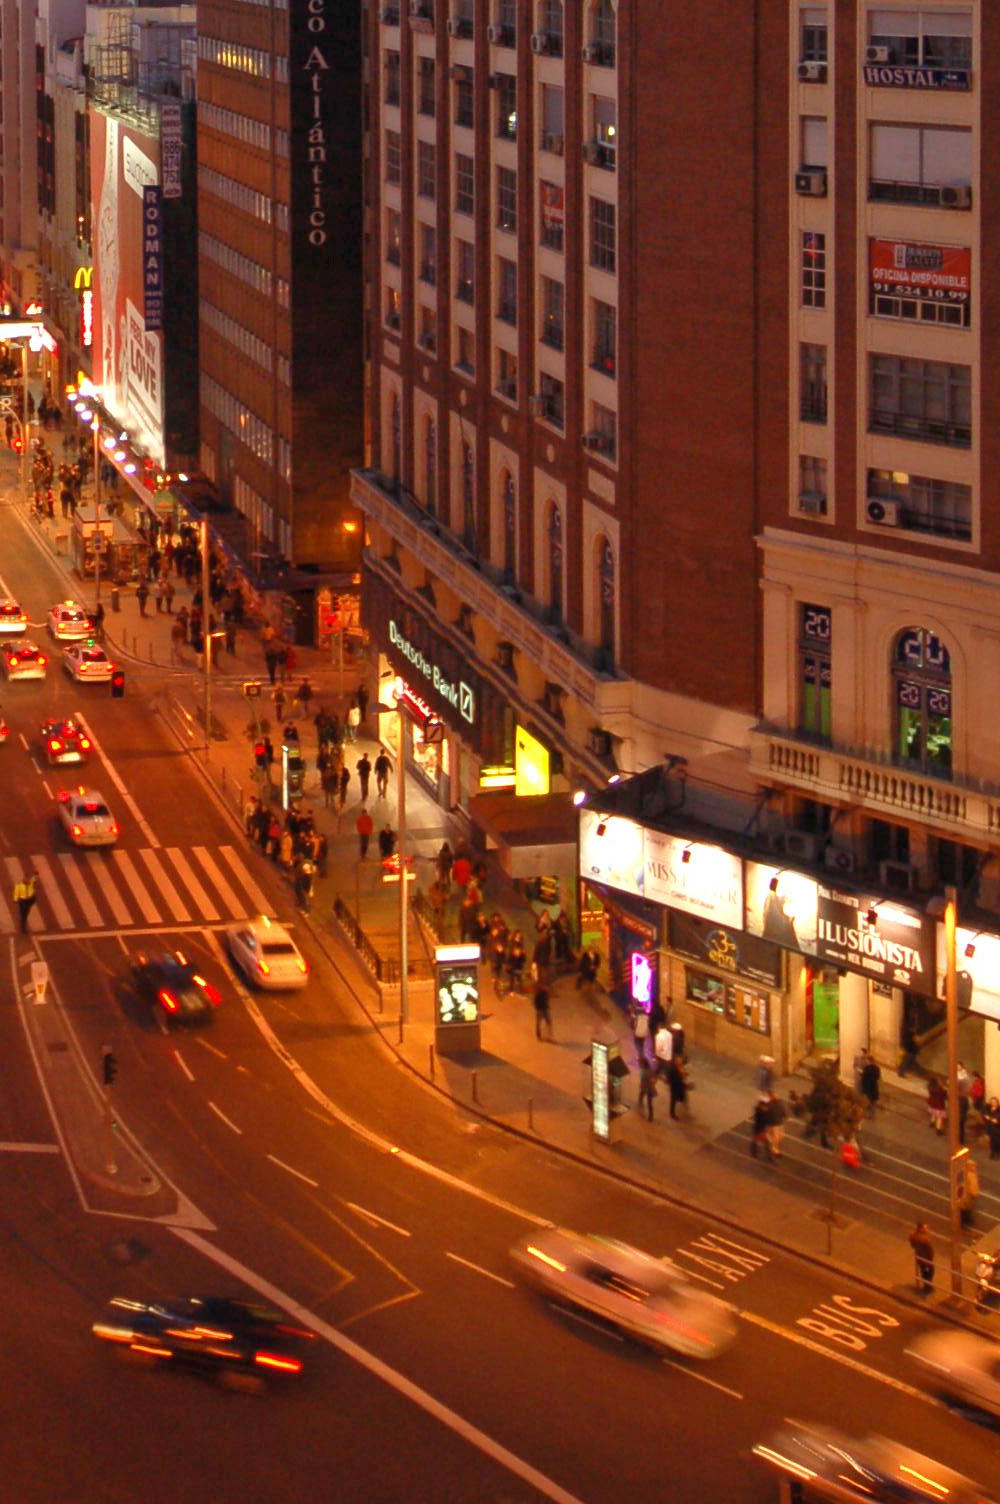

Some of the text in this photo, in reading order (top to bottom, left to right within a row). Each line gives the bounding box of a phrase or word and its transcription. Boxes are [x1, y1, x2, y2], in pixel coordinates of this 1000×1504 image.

[865, 67, 938, 87] HOSTAL
[303, 46, 329, 246] Atlántico
[145, 191, 161, 286] RODMAN
[131, 339, 157, 404] LOVE
[805, 611, 830, 638] 20
[389, 619, 432, 680] Deutsche
[433, 665, 458, 709] Bank
[900, 683, 919, 704] 20
[929, 690, 949, 712] 20
[818, 917, 923, 973] ILUSIONISTA
[796, 1294, 900, 1351] BUS
